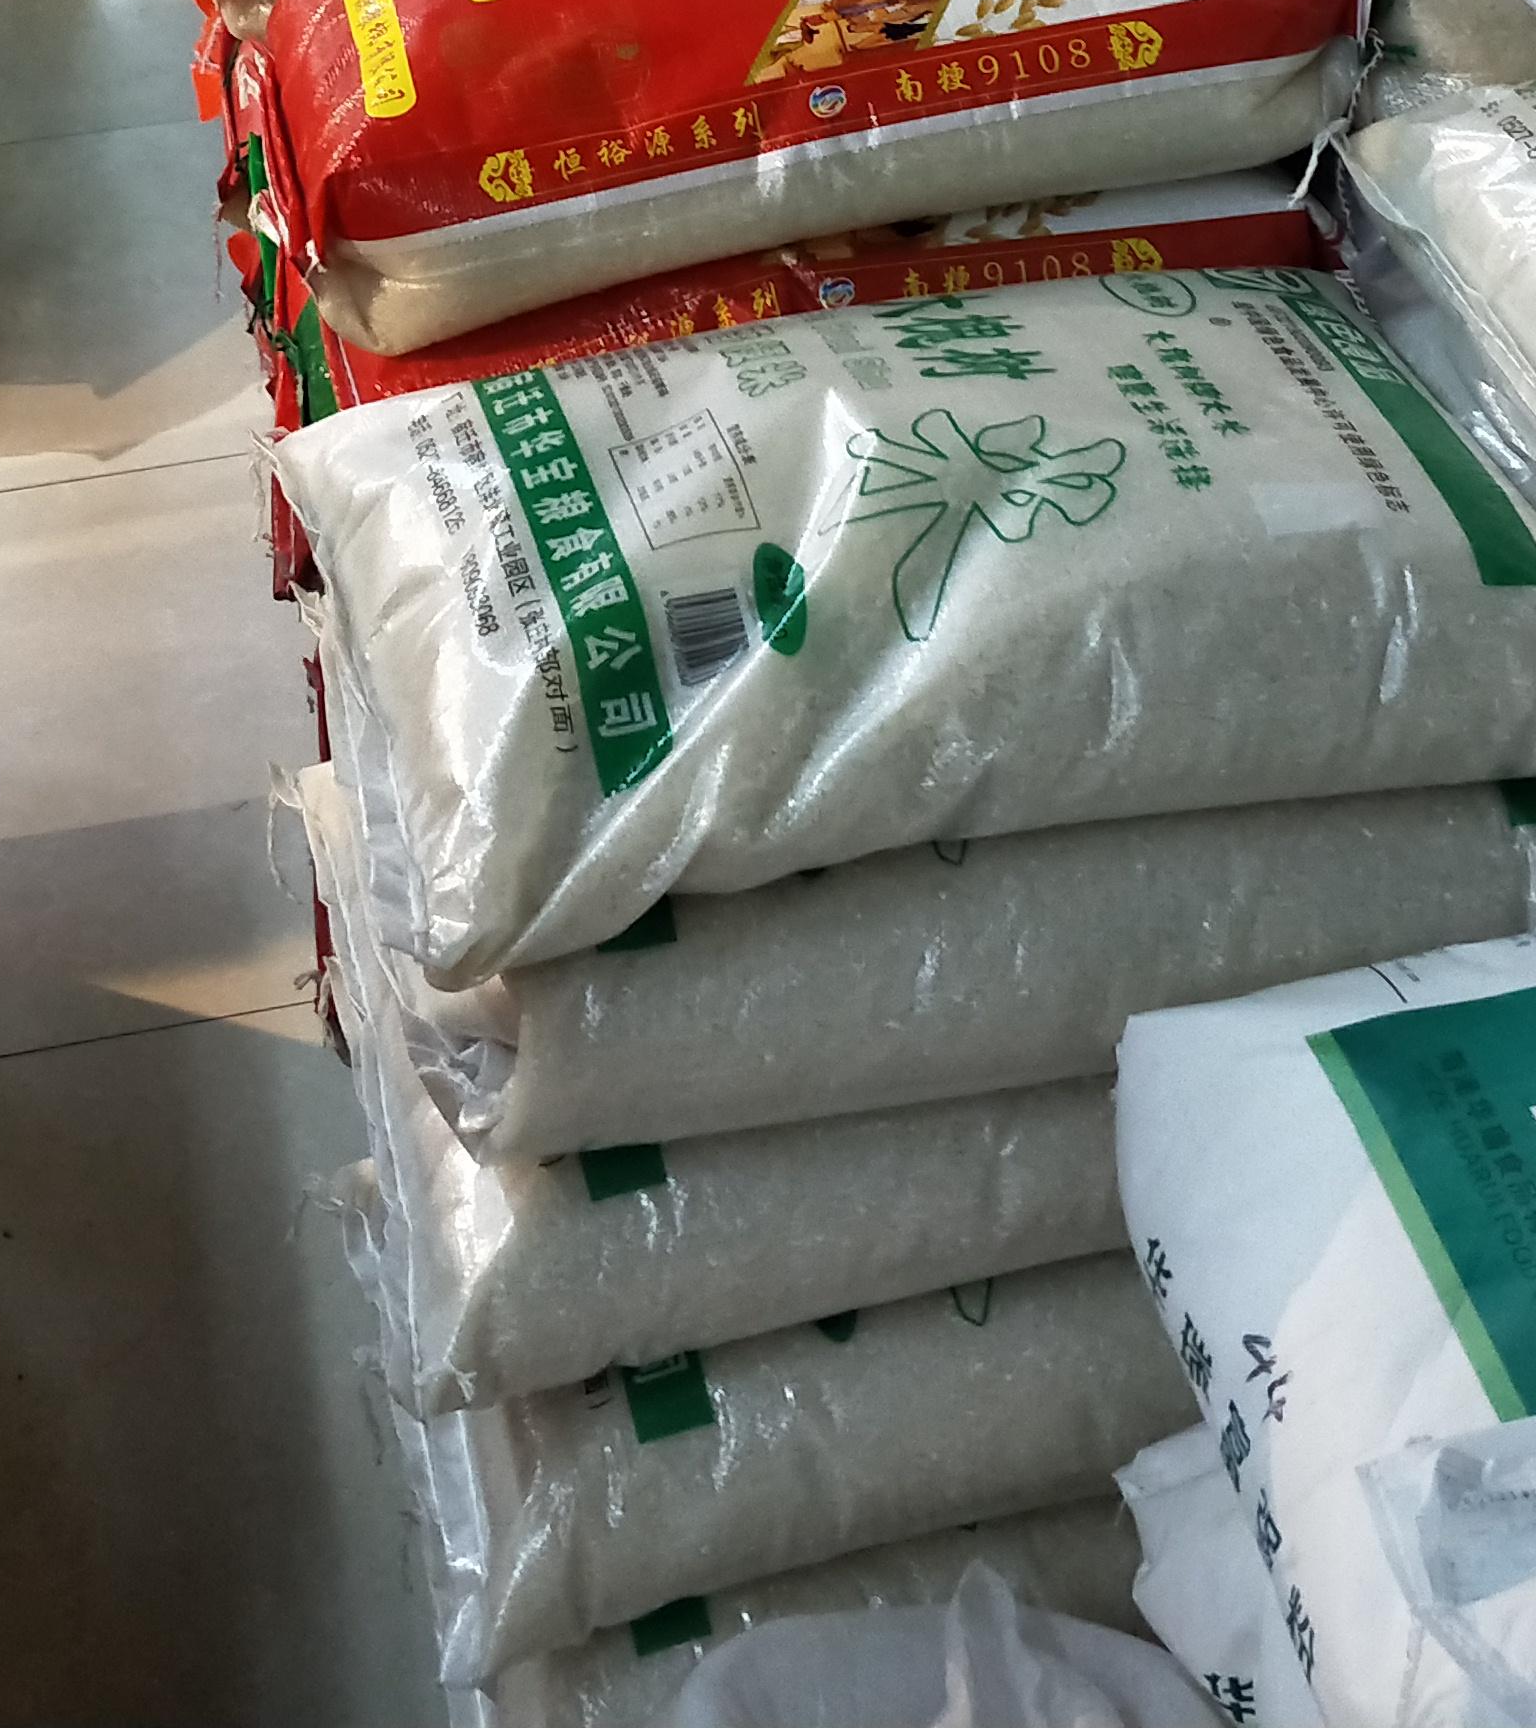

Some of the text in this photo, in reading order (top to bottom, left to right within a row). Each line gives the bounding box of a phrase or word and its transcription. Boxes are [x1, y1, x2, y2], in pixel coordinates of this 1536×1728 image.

[894, 38, 1094, 104] 南粳9108
[552, 101, 765, 180] 恒裕源系列
